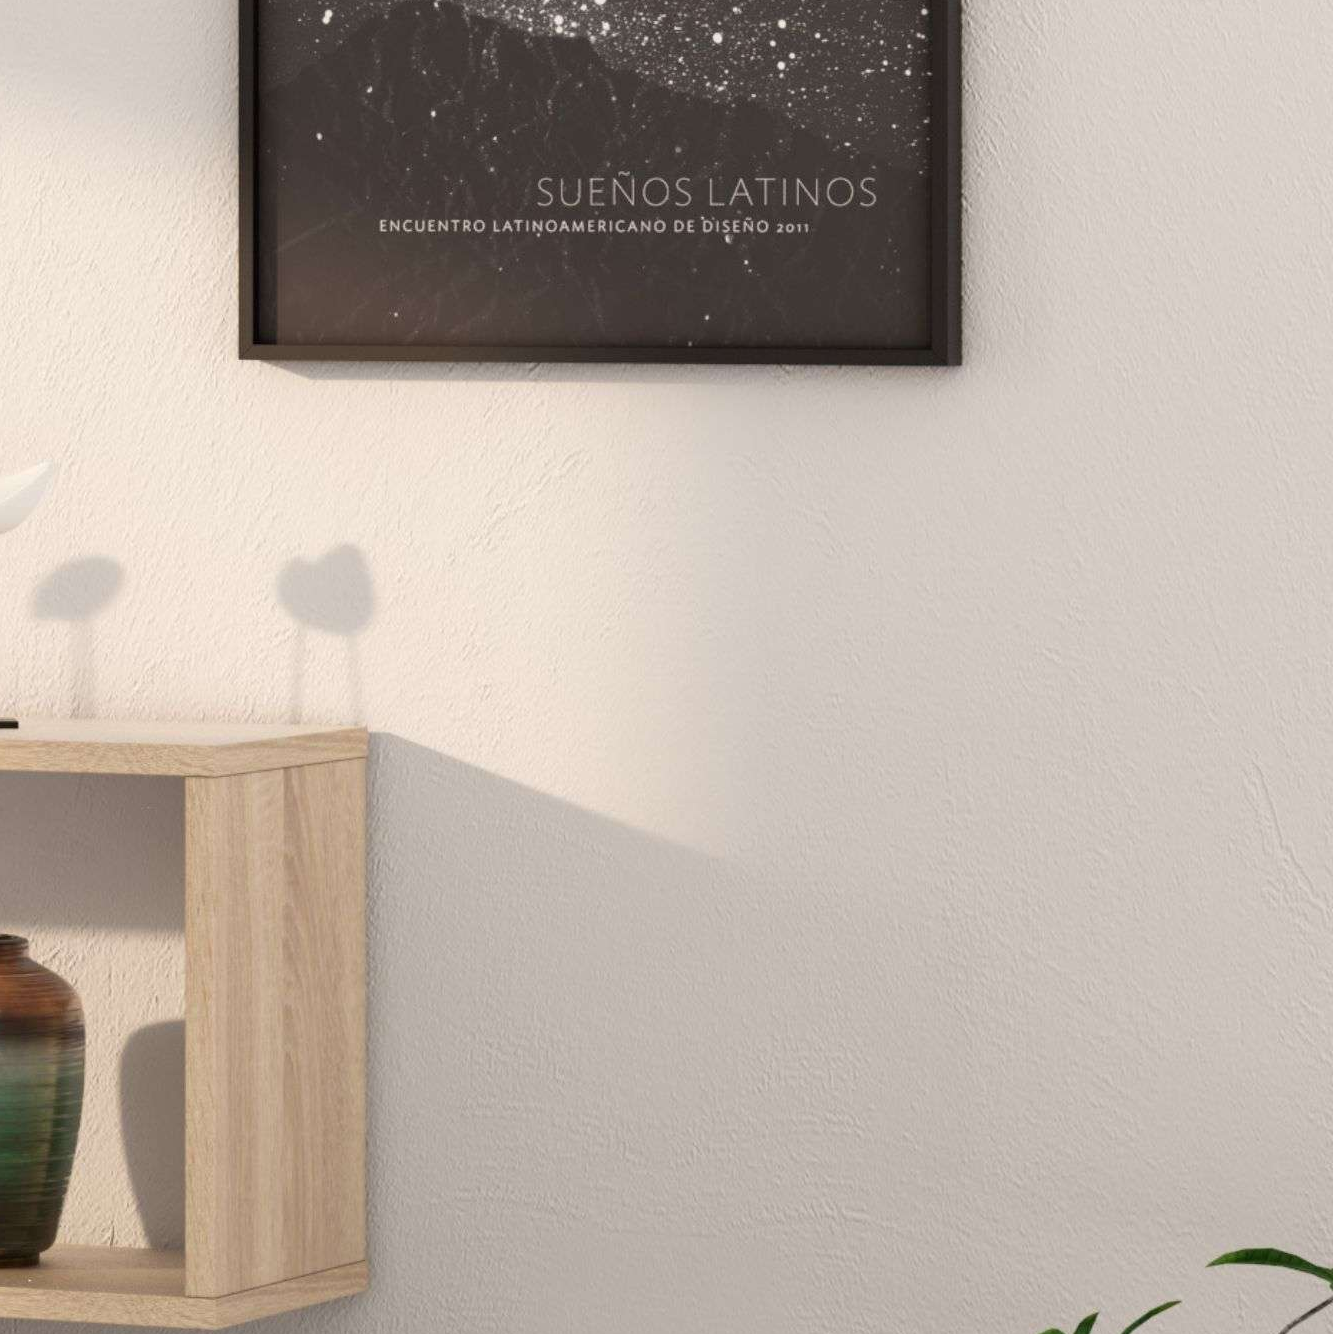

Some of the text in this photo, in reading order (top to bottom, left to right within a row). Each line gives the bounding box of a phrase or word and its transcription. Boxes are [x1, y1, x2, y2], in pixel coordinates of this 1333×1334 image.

[537, 171, 879, 207] SUEÑOS LATINOS
[379, 216, 810, 235] ENCUENTRO LATINOAMERICANO DE DISEÑO 2011
